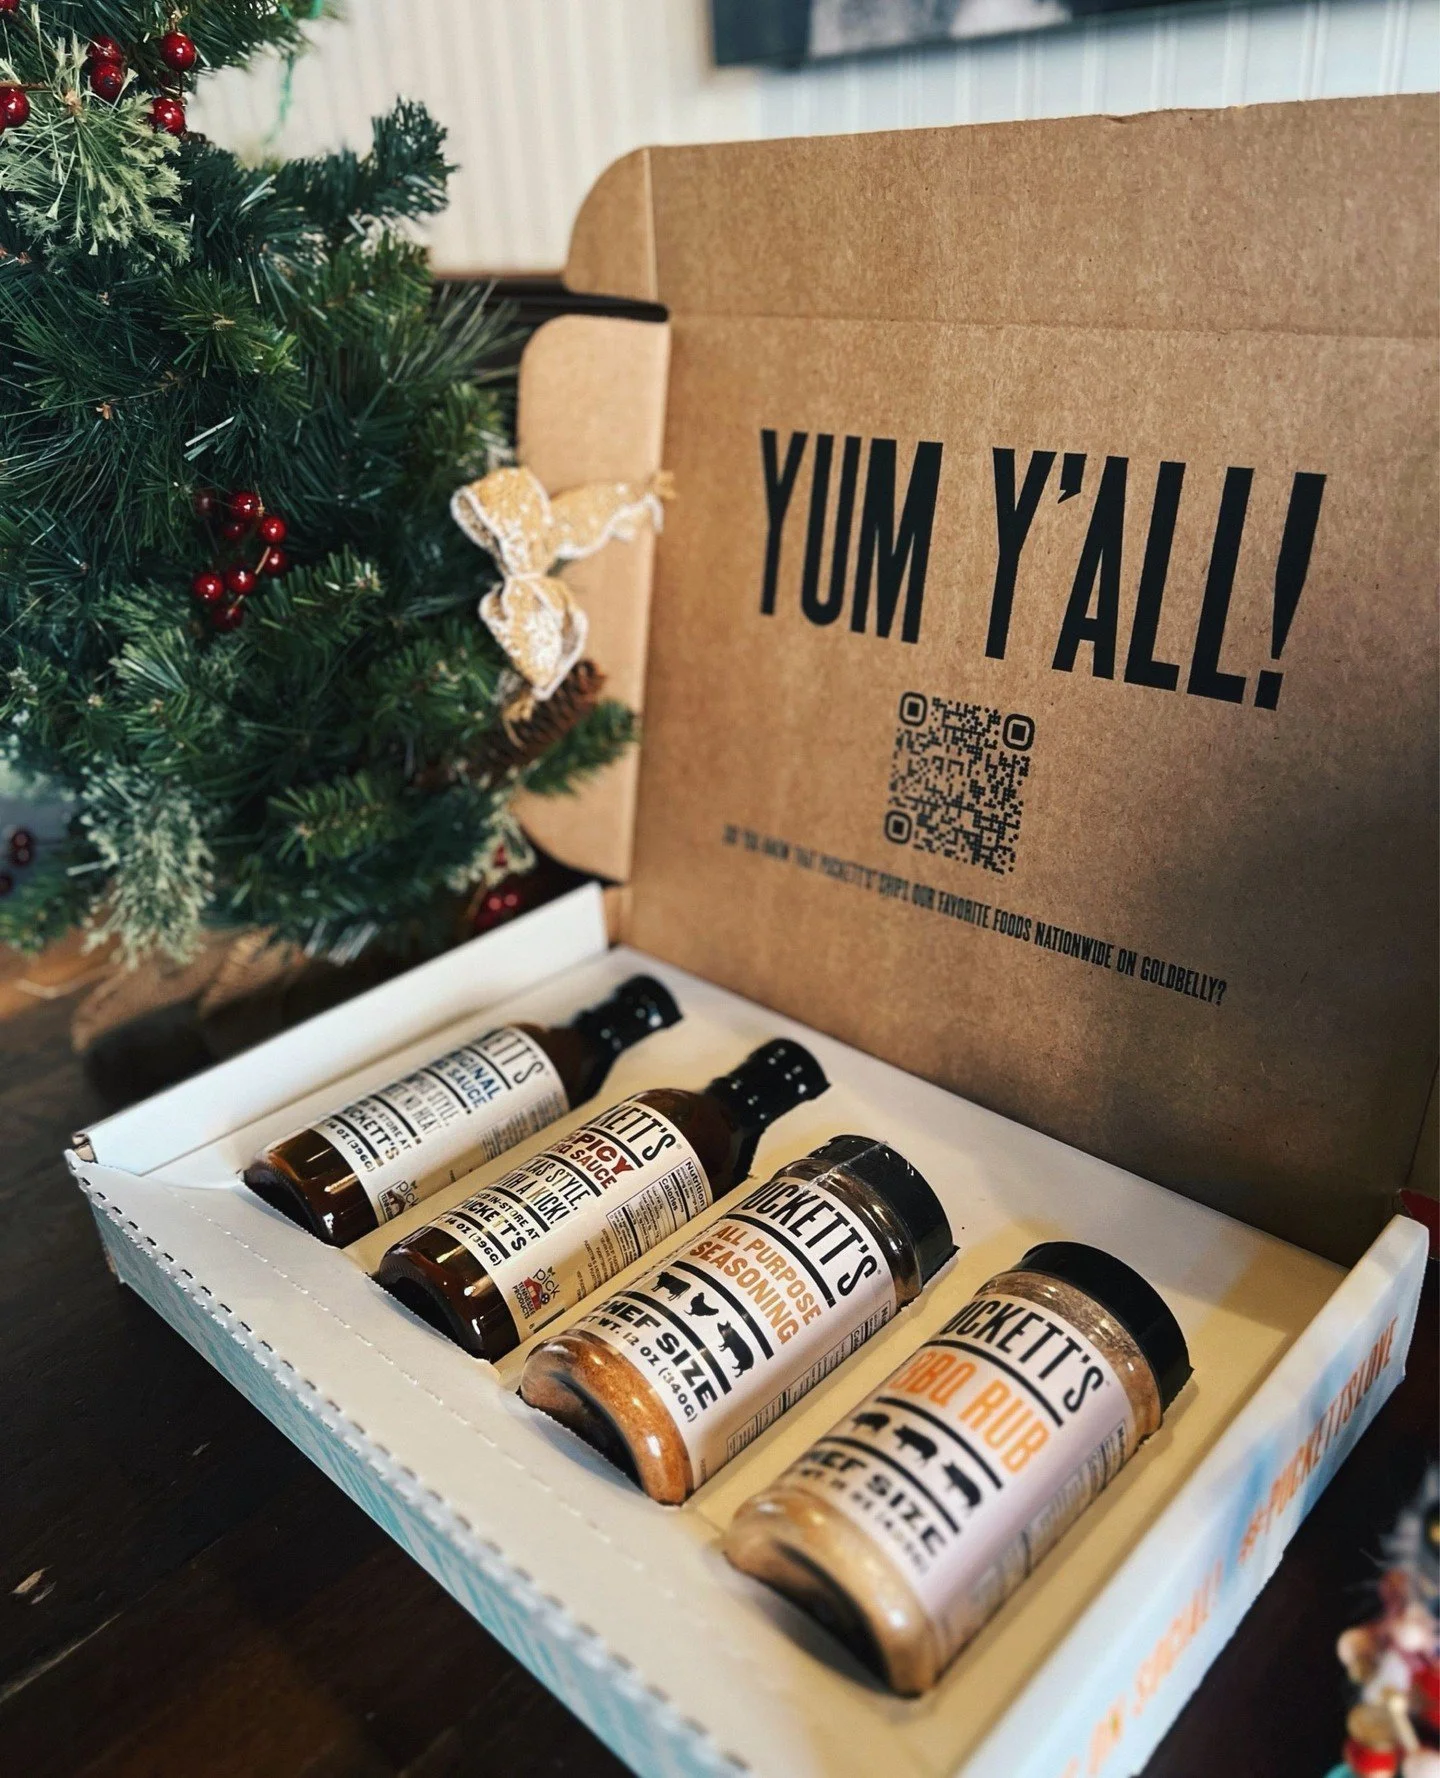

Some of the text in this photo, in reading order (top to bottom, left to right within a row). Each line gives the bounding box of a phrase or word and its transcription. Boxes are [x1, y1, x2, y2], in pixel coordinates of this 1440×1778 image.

[760, 429, 1327, 711] YUM Y'ALL!
[937, 891, 992, 930] FAVORITE
[992, 908, 1032, 942] FOODS
[1034, 922, 1115, 970] NATIONWIDE
[1116, 947, 1138, 977] ON
[1140, 956, 1227, 1006] GOLDBELLY?
[343, 1105, 400, 1160] CKETT'S
[519, 1180, 538, 1195] A
[545, 1168, 591, 1211] STYLE,
[569, 1149, 618, 1190] SAUCE
[662, 1176, 679, 1212] Calories
[685, 1159, 706, 1208] Nutrition
[462, 1200, 528, 1251] UCKETT'S
[488, 1194, 529, 1228] IN-STORE
[525, 1227, 541, 1240] AT
[527, 1186, 571, 1224] KICK!
[456, 1222, 471, 1235] OZ
[468, 1233, 502, 1266] (396G)
[742, 1181, 878, 1297] UCKETT'S
[533, 1268, 560, 1299] pick
[689, 1241, 800, 1345] SEASONING
[712, 1225, 822, 1326] ALL PURPOSE
[597, 1317, 622, 1334] WT.
[622, 1332, 639, 1347] 12
[640, 1346, 660, 1367] OZ
[598, 1300, 662, 1329] HEF
[655, 1332, 718, 1411] SIZE
[939, 1300, 1104, 1414] UCKETT'S
[957, 1379, 1050, 1474] RUB
[865, 1473, 947, 1556] SIZE
